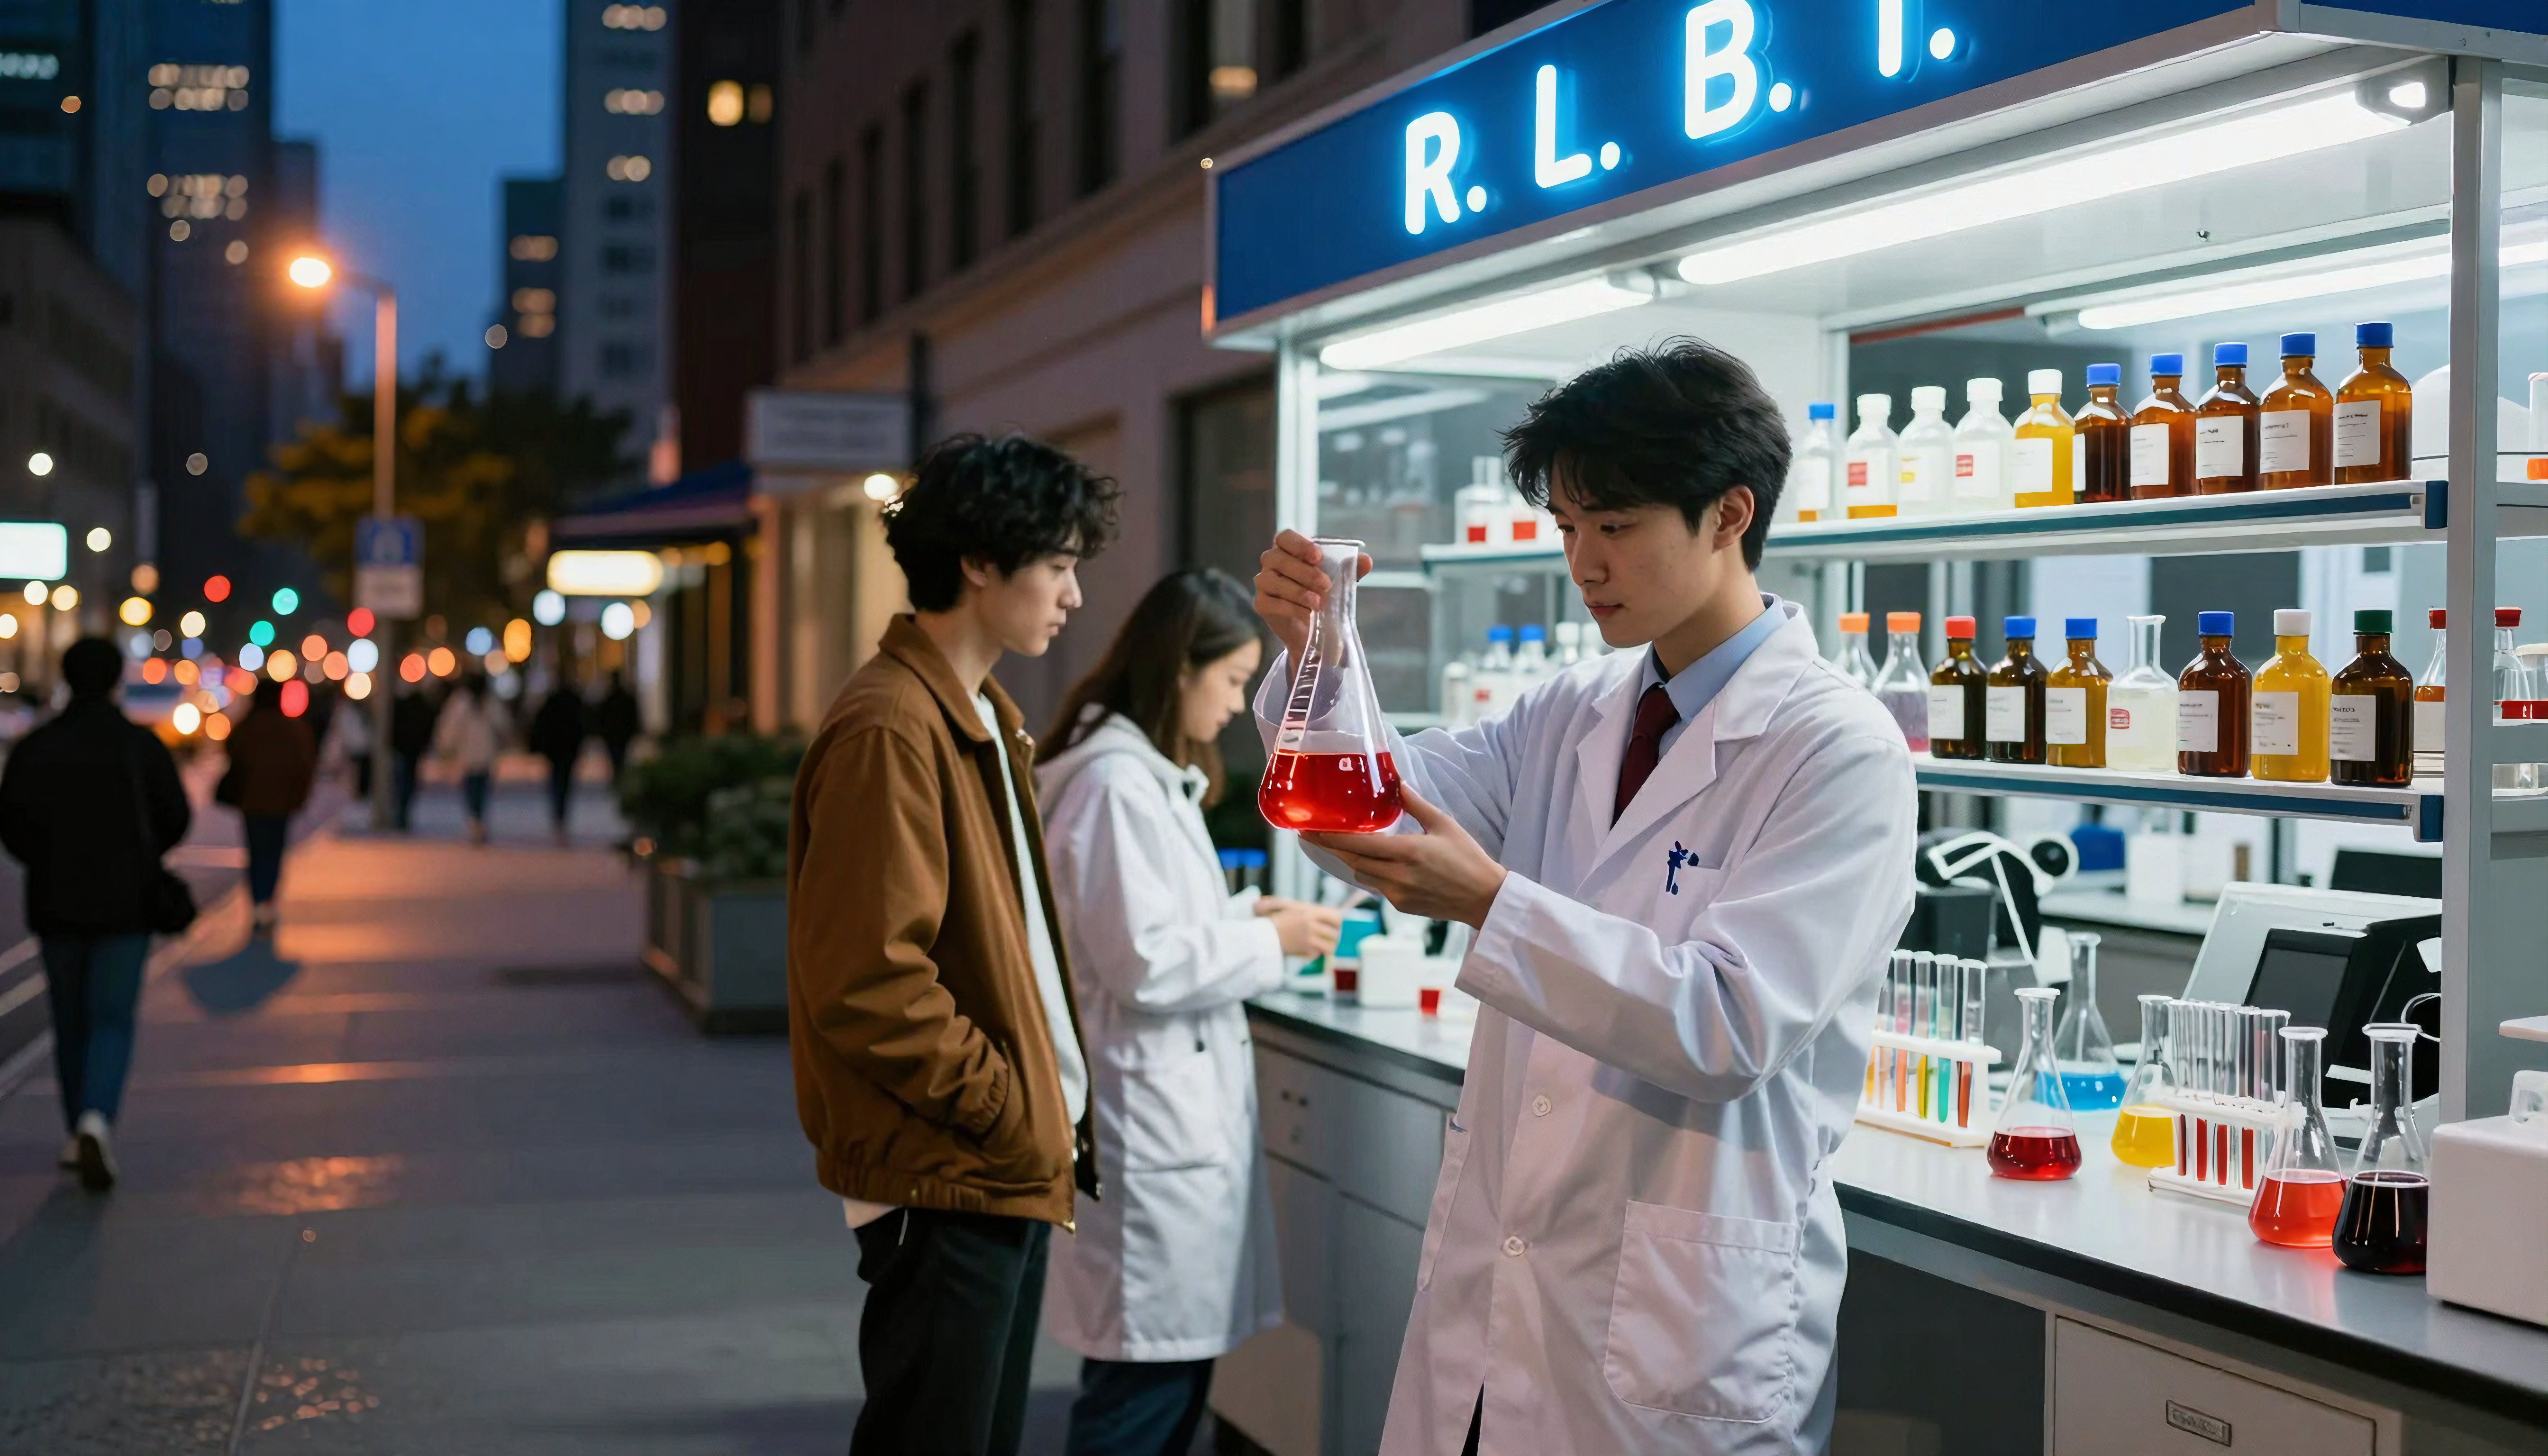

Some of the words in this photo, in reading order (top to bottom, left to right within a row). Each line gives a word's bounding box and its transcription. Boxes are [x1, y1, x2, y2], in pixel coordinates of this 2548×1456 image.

[1405, 111, 1487, 235] R.
[1535, 64, 1621, 189] L.
[1684, 0, 1793, 140] B.
